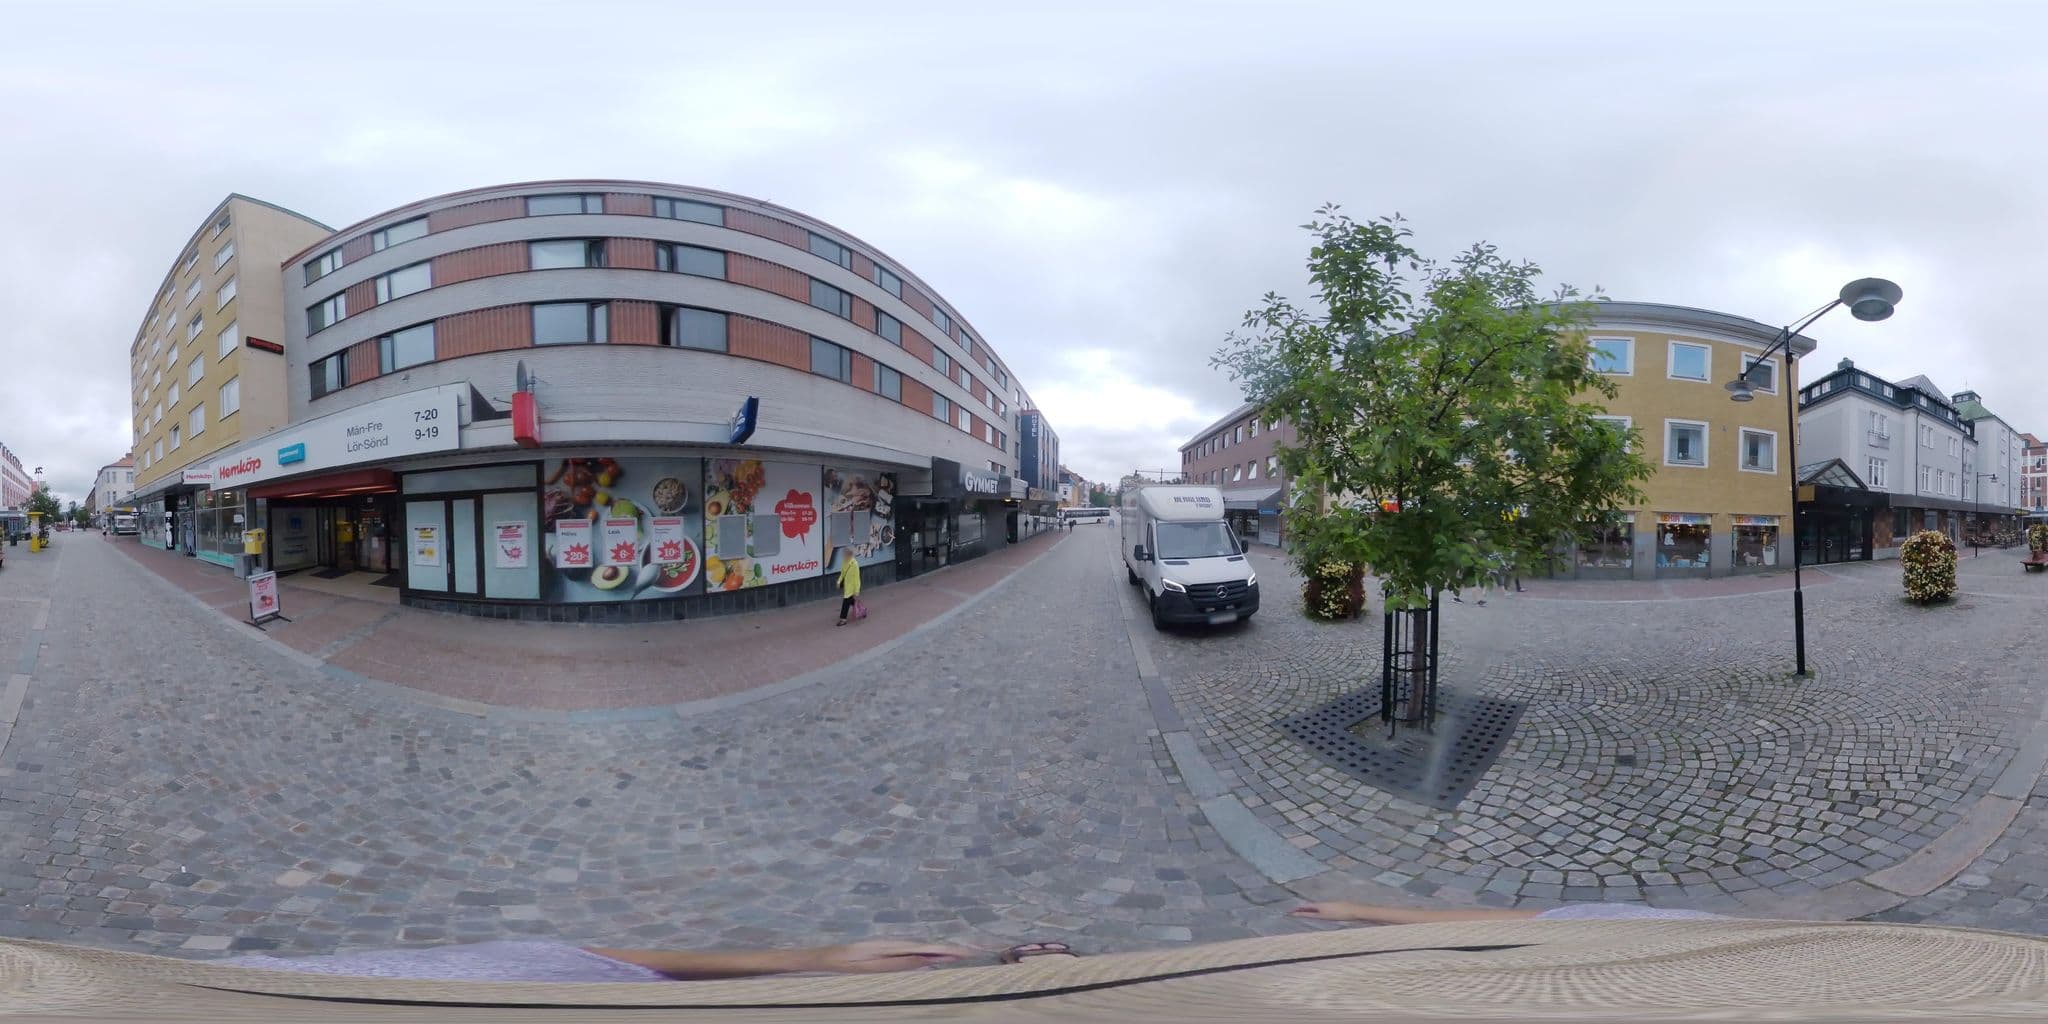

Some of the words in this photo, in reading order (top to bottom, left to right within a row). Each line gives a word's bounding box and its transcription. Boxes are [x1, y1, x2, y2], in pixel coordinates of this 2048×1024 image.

[346, 422, 383, 438] Mån-Fre
[414, 408, 438, 423] 7-20
[347, 434, 389, 453] Lör-Sönd
[414, 426, 439, 440] 9-19
[186, 472, 213, 480] Hemköp
[219, 457, 262, 480] Hemköp
[964, 471, 998, 494] GYMMET
[771, 559, 819, 575] Hemköp
